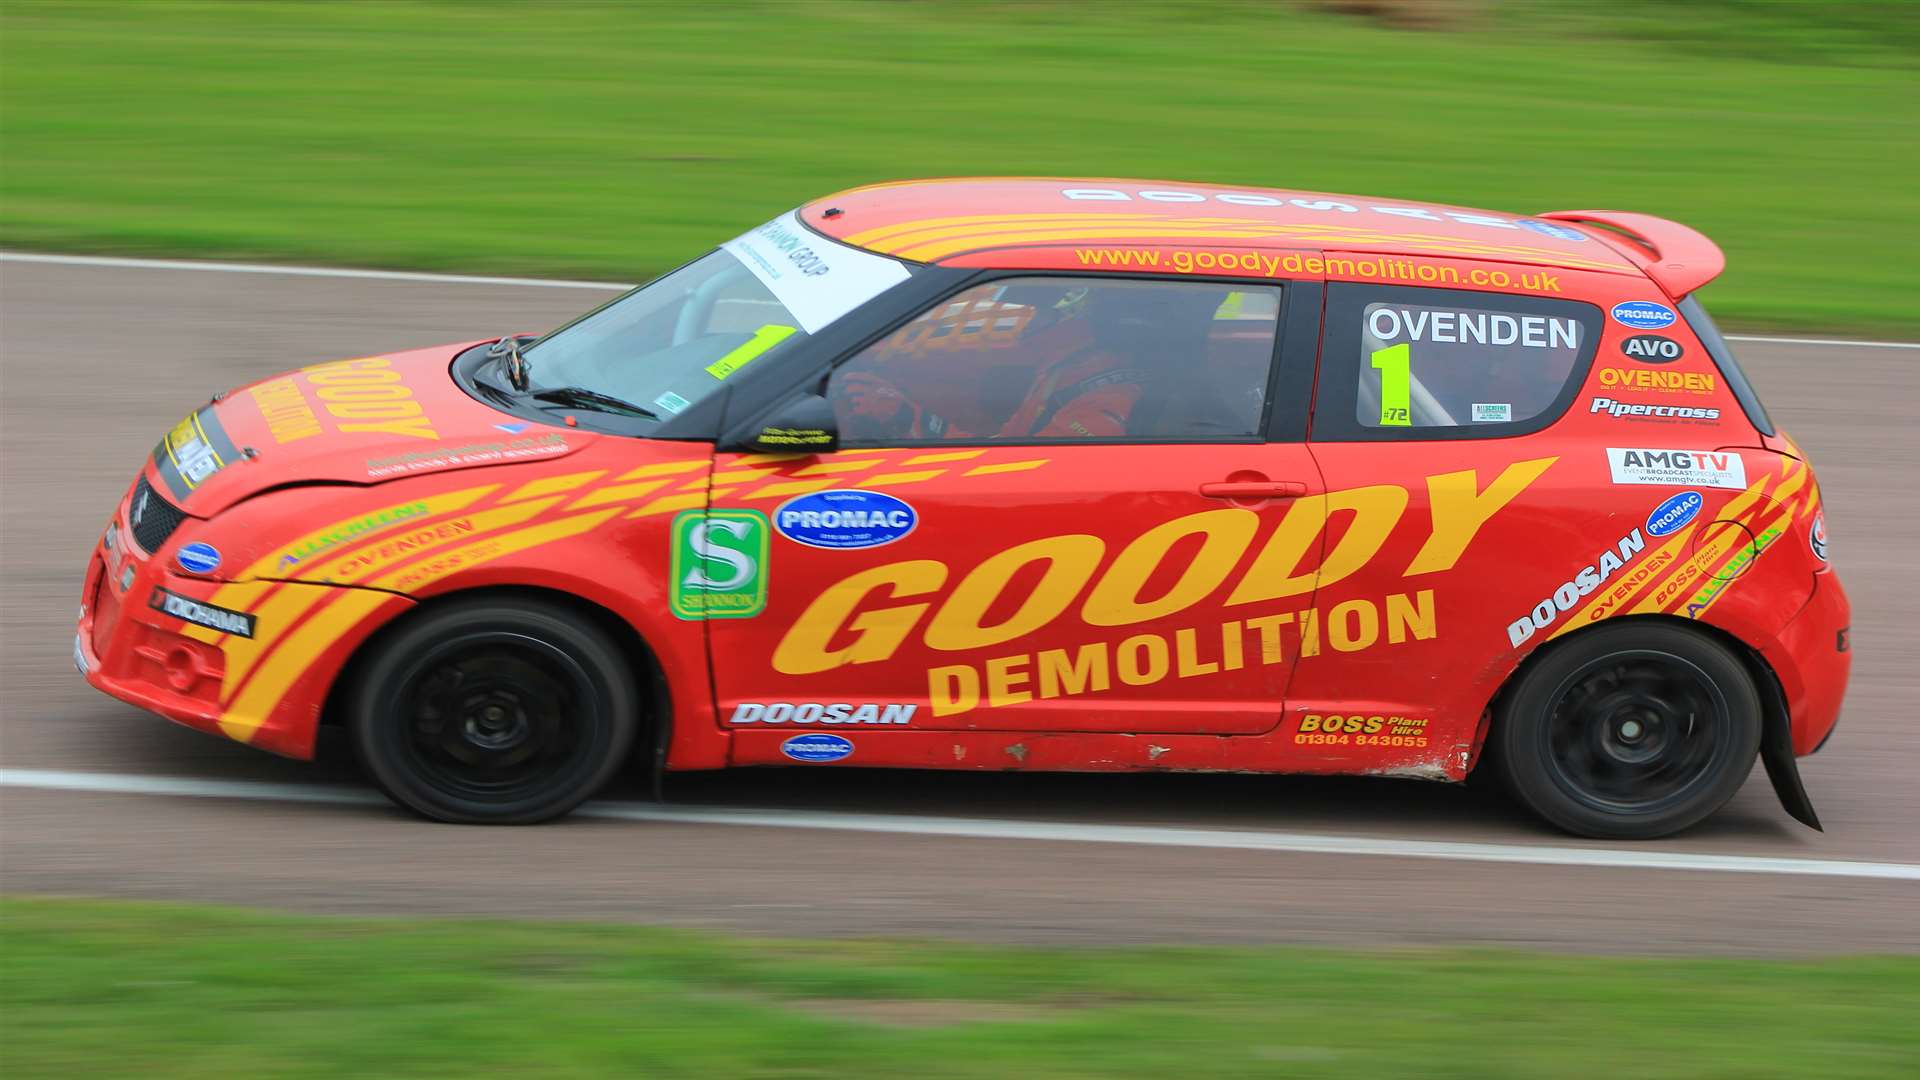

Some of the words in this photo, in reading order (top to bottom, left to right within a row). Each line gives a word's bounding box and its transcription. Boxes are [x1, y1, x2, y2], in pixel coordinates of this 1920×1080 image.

[1061, 188, 1520, 230] DOOSAN
[789, 248, 829, 276] GROUP
[1075, 248, 1561, 292] www.goodydemolition.co.uk
[1369, 308, 1577, 349] OVENDEN
[1615, 309, 1673, 320] PROMAC
[704, 324, 797, 381] 1
[1625, 338, 1679, 358] AVO
[1371, 343, 1412, 425] 1
[1599, 368, 1715, 390] OVENDEN
[1383, 408, 1408, 421] #72
[1590, 397, 1720, 419] Pipercross
[1623, 451, 1728, 471] AMGTV
[1639, 475, 1720, 484] www.amgtv.co.uk
[782, 511, 909, 529] PROMAC
[1649, 495, 1699, 533] PROMAC
[338, 519, 473, 576] OVENDEN
[682, 519, 757, 591] S
[772, 455, 1559, 675] GOODY
[1686, 528, 1780, 619] ALLSCREENS
[1507, 527, 1645, 648] DOOSAN
[1590, 550, 1673, 621] OVENDEN
[1656, 564, 1697, 606] BOSS
[929, 590, 1437, 718] DEMOLITION
[730, 703, 918, 724] DOOSAN
[1299, 715, 1384, 733] BOSS
[1387, 717, 1428, 727] Plant
[1294, 734, 1349, 745] 01304
[1355, 735, 1428, 748] 843055
[1390, 726, 1423, 736] Hire
[785, 743, 849, 753] PROMAC
